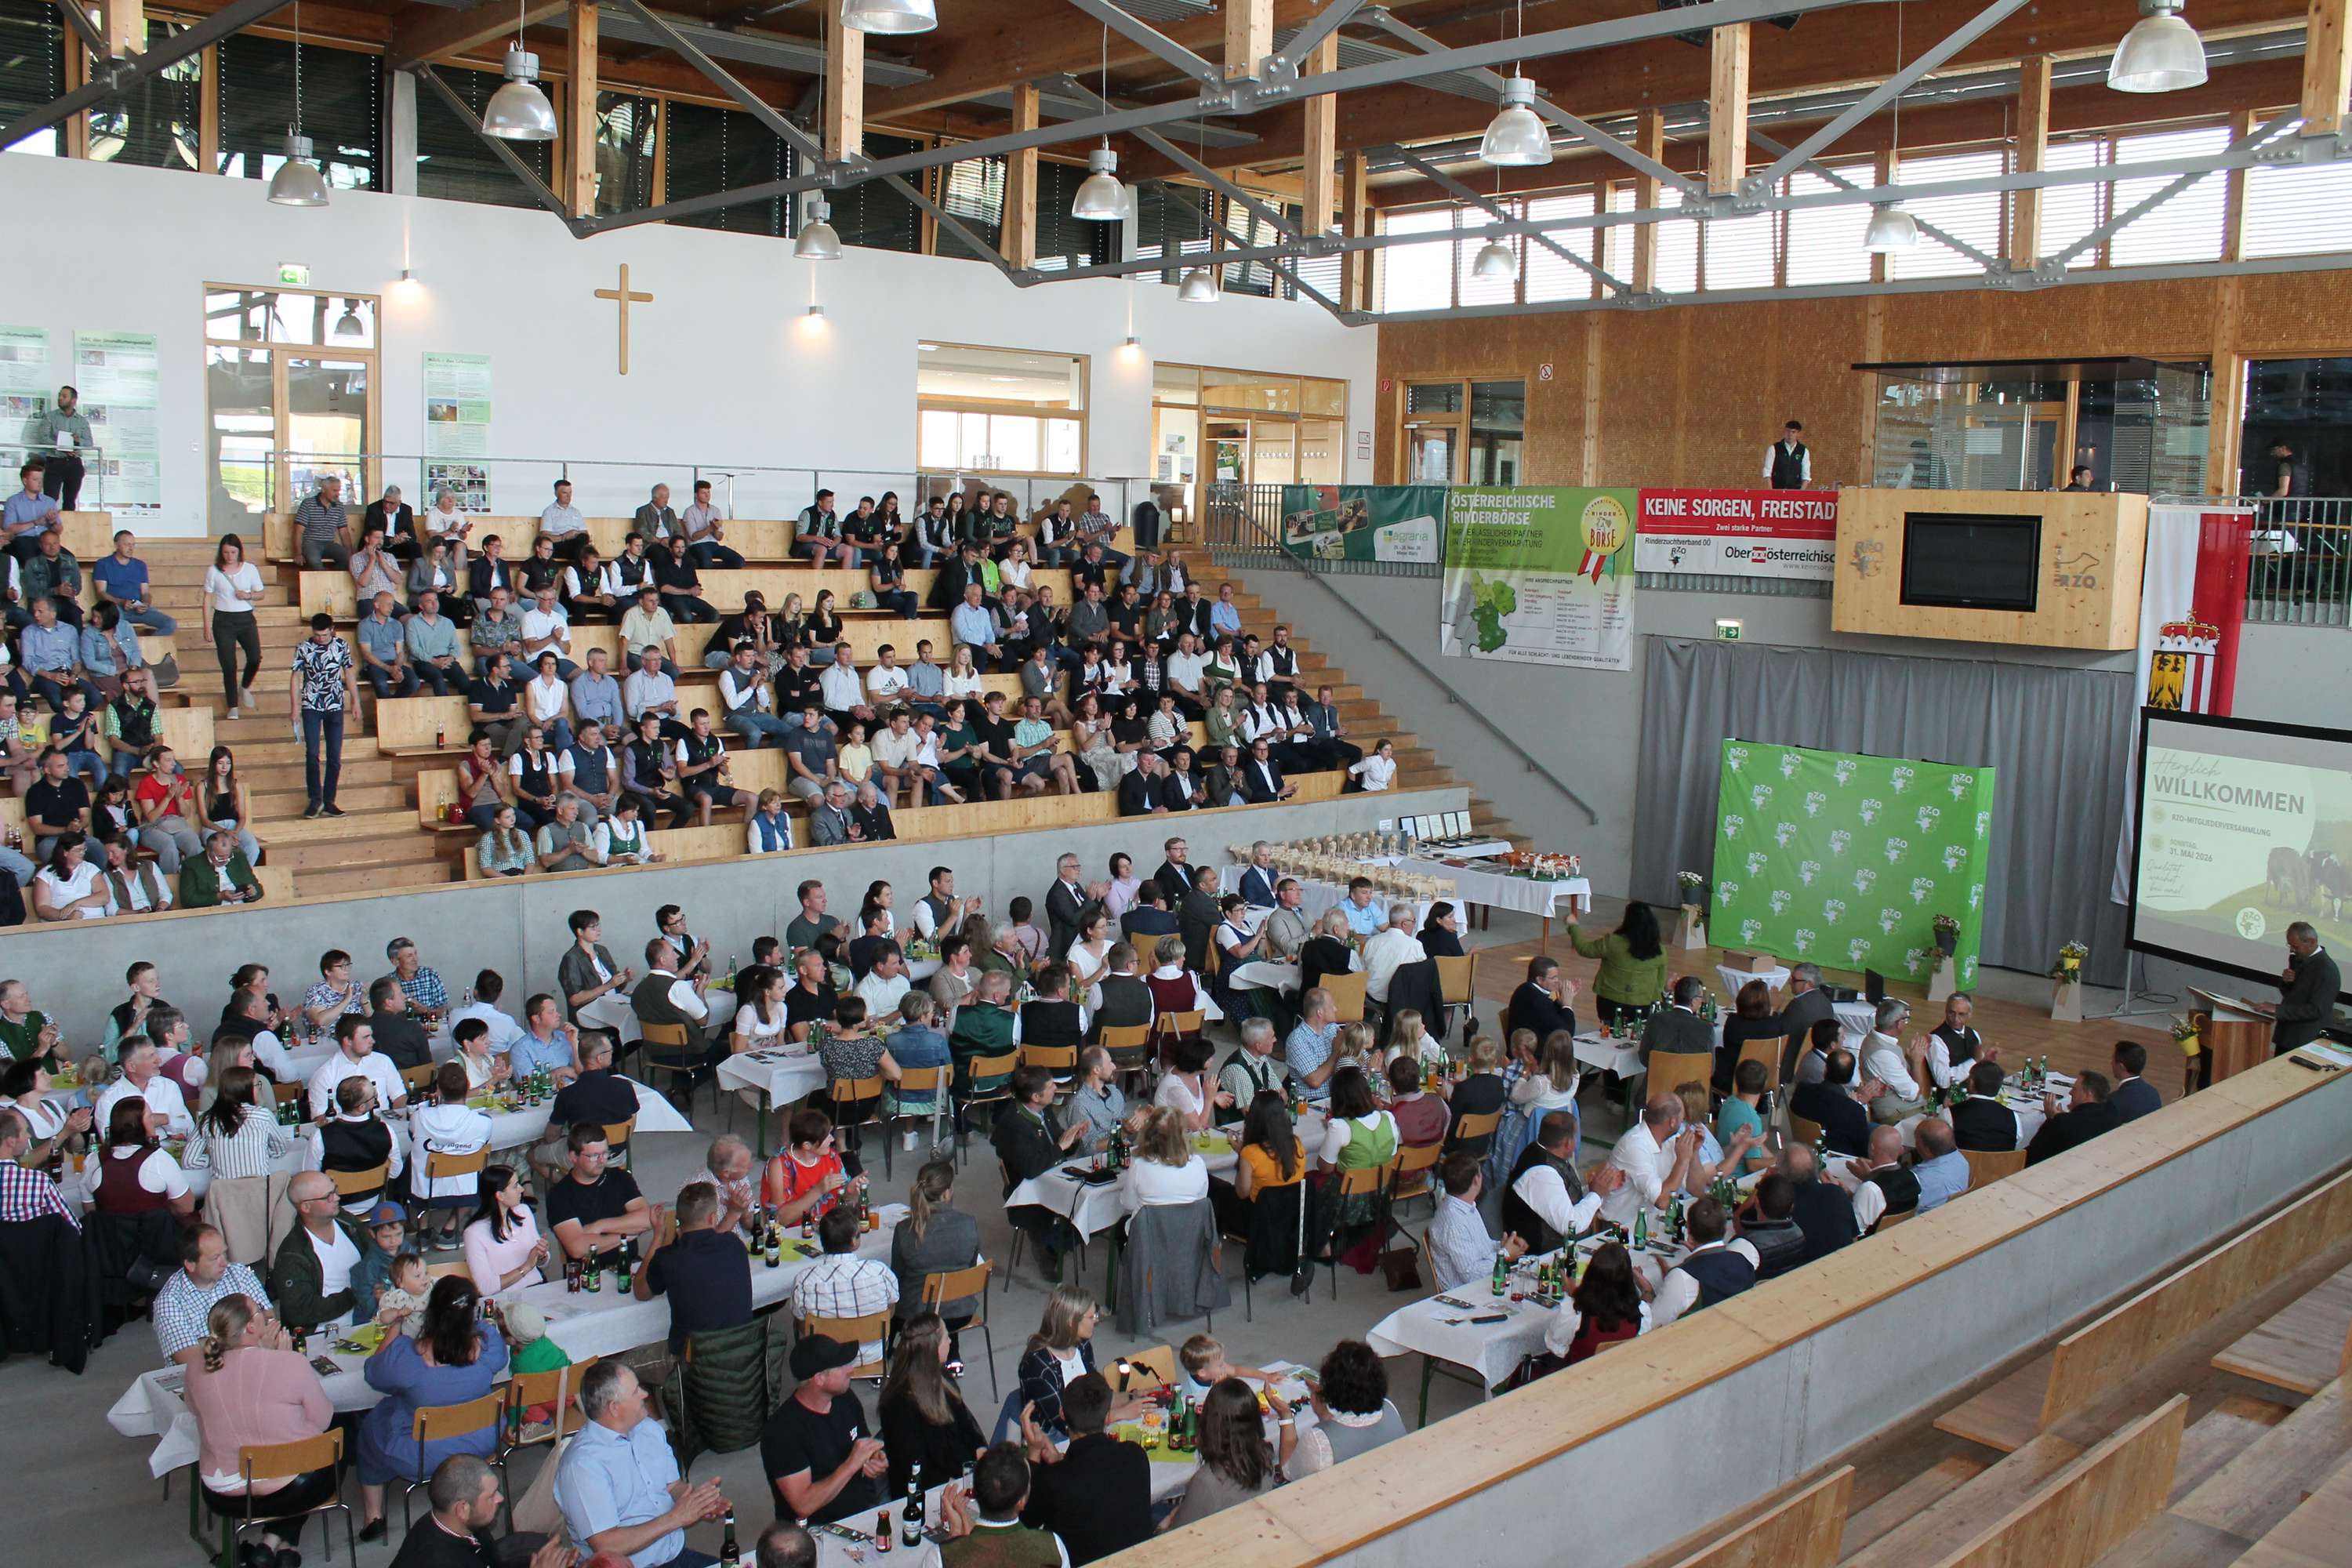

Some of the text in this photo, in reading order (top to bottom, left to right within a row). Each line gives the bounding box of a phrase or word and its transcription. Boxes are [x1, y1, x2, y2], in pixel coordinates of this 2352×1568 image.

[1453, 492, 1555, 509] ÖSTERREICHISCHE
[1645, 498, 1838, 521] KEINE SORGEN, FREISTAD
[1453, 509, 1530, 525] RINDERBÖRSE
[1715, 523, 1773, 533] Zwei starke Partner
[1392, 530, 1428, 543] agraria
[1644, 537, 1701, 546] Rinderzuchtverband
[1671, 546, 1687, 556] RZO
[1725, 546, 1751, 559] Ober
[1730, 747, 1748, 757] RZO
[1783, 753, 1801, 764] RZO
[1837, 760, 1857, 770] RZO
[2151, 752, 2221, 778] Herzlich
[1893, 766, 1914, 777] RZO
[1952, 773, 1973, 784] RZO
[1754, 785, 1772, 794] RZO
[2154, 774, 2304, 815] WILLKOMMEN
[1807, 792, 1826, 801] RZO
[1862, 798, 1882, 809] RZO
[1919, 806, 1940, 816] RZO
[1726, 815, 1744, 825] RZO
[2171, 814, 2271, 837] RZO-MITGLIEDERVERSAMMLUNG
[1778, 822, 1796, 832] RZO
[1831, 829, 1851, 840] RZO
[1887, 837, 1907, 848] RZO
[1946, 845, 1967, 856] RZO
[2169, 847, 2213, 862] 31. MAI 2026
[1749, 852, 1767, 862] RZO
[1802, 860, 1820, 871] RZO
[1857, 869, 1876, 879] RZO
[1720, 881, 1738, 891] RZO
[1913, 877, 1933, 888] RZO
[1773, 890, 1791, 901] RZO
[1827, 899, 1846, 909] RZO
[1882, 908, 1902, 919] RZO
[1744, 919, 1762, 929] RZO
[1797, 928, 1816, 939] RZO
[1851, 938, 1871, 949] RZO
